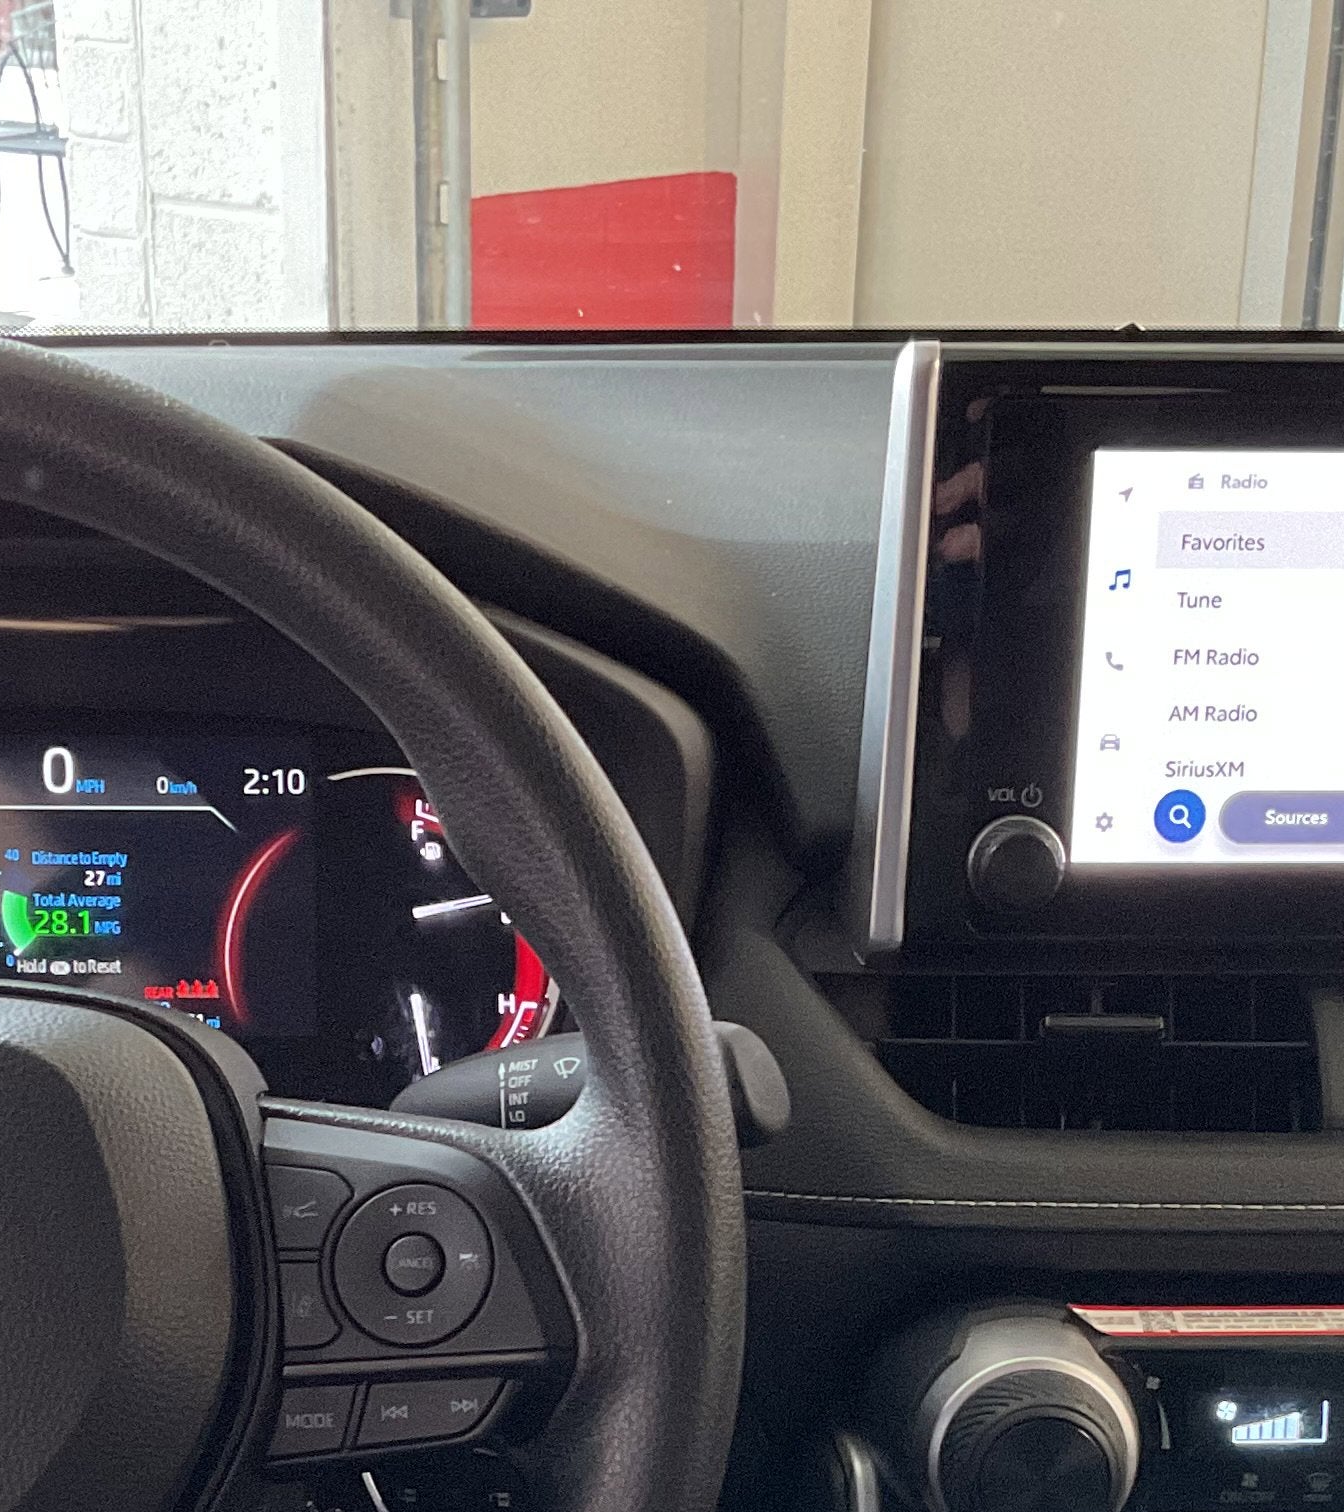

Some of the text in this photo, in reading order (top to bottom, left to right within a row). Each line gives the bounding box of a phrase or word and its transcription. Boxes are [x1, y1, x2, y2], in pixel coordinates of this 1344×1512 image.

[1220, 474, 1268, 490] Radio
[1181, 533, 1265, 551] Favorites
[1177, 591, 1222, 609] Tune
[1173, 648, 1260, 665] FM Radio
[1168, 704, 1258, 722] AM Radio
[42, 746, 106, 794] 0 MPH
[1165, 760, 1244, 778] SiriusXM
[156, 776, 198, 795] 0 km/h
[243, 768, 306, 796] 2:10
[1264, 810, 1328, 826] Sources
[411, 820, 424, 841] F
[4, 848, 20, 861] 40
[31, 850, 128, 868] Distance to Empty
[83, 870, 122, 887] 27 mi
[32, 892, 122, 910] Total Average
[34, 909, 122, 935] 28.1 MPG
[16, 958, 47, 974] Hold
[73, 959, 87, 974] to
[87, 958, 122, 974] Reset
[498, 992, 516, 1015] H
[508, 1058, 539, 1073] MIST
[508, 1074, 533, 1089] OFF
[508, 1091, 529, 1106] INT
[509, 1109, 526, 1123] LO
[406, 1201, 437, 1216] RES
[406, 1310, 434, 1325] SET
[285, 1413, 334, 1429] MODE
